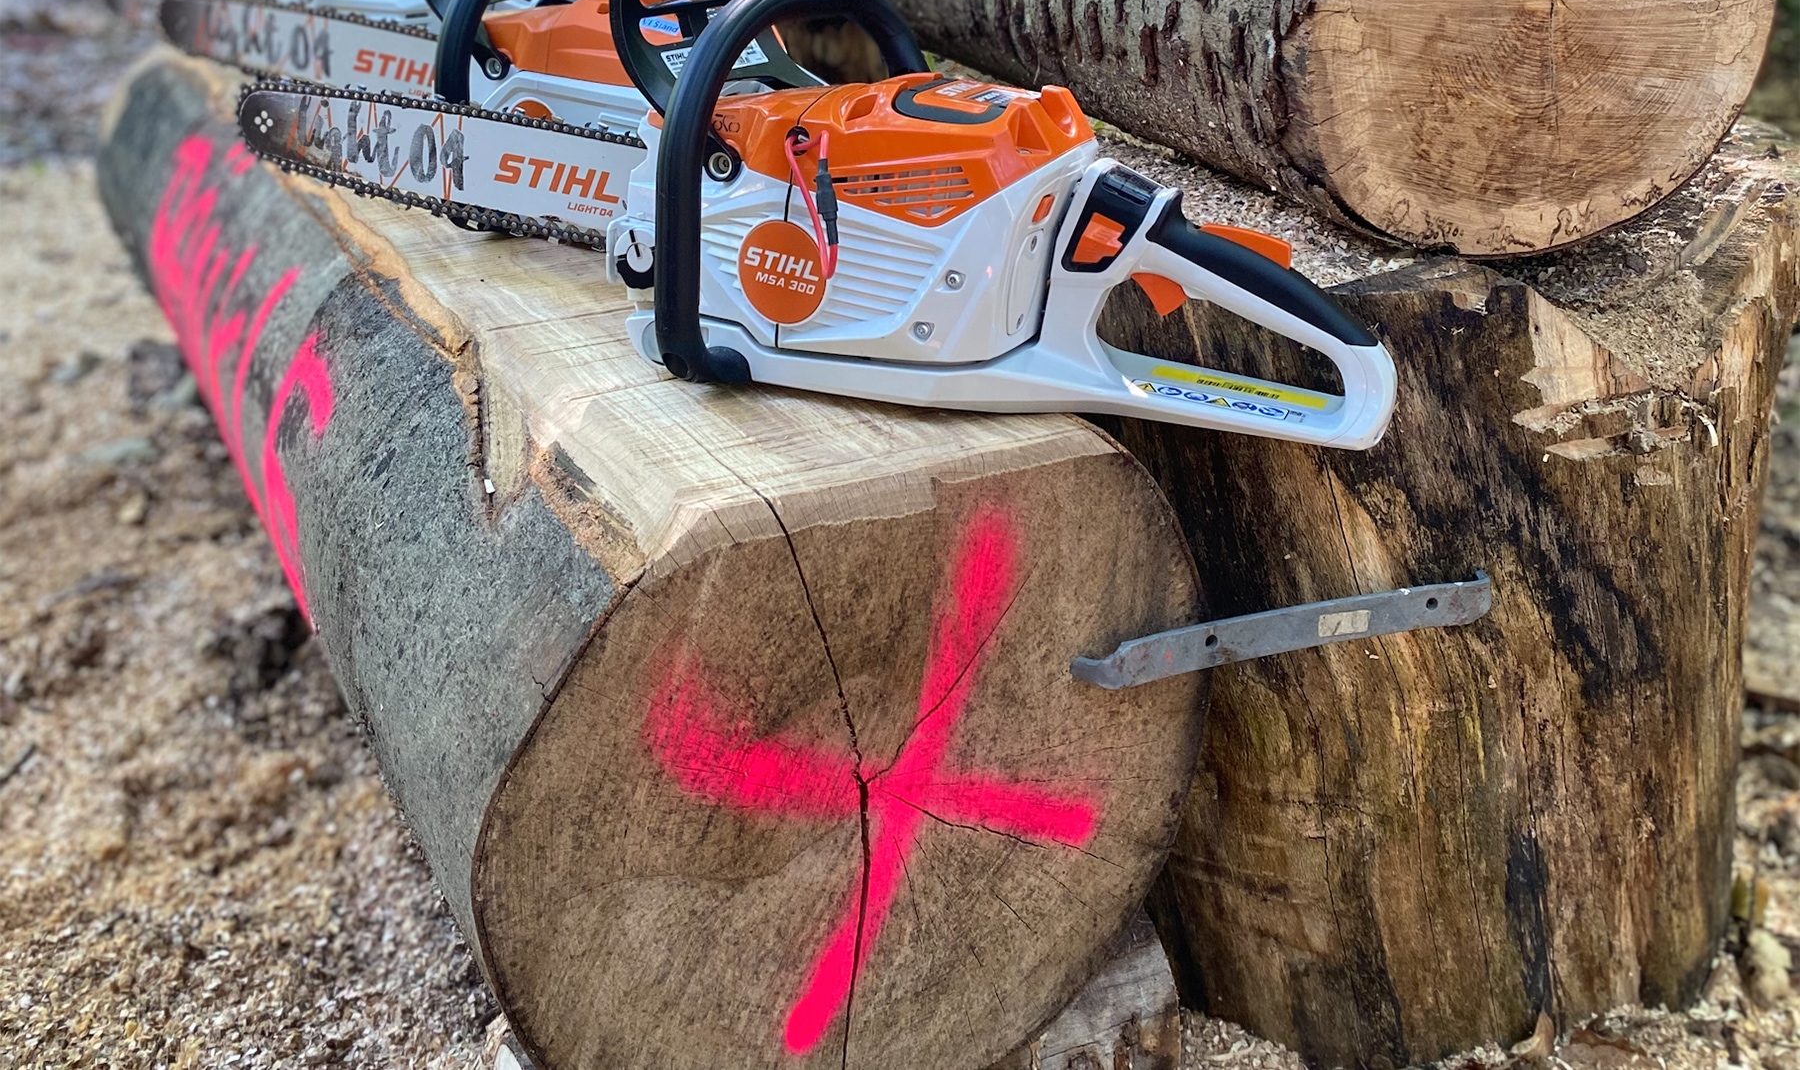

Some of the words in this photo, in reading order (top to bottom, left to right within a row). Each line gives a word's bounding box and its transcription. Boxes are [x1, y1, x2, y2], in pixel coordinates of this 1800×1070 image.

[493, 152, 620, 205] STIHL
[567, 201, 600, 215] LIGHT
[743, 246, 820, 282] STIHL
[755, 271, 785, 288] MSA
[788, 280, 816, 296] 300
